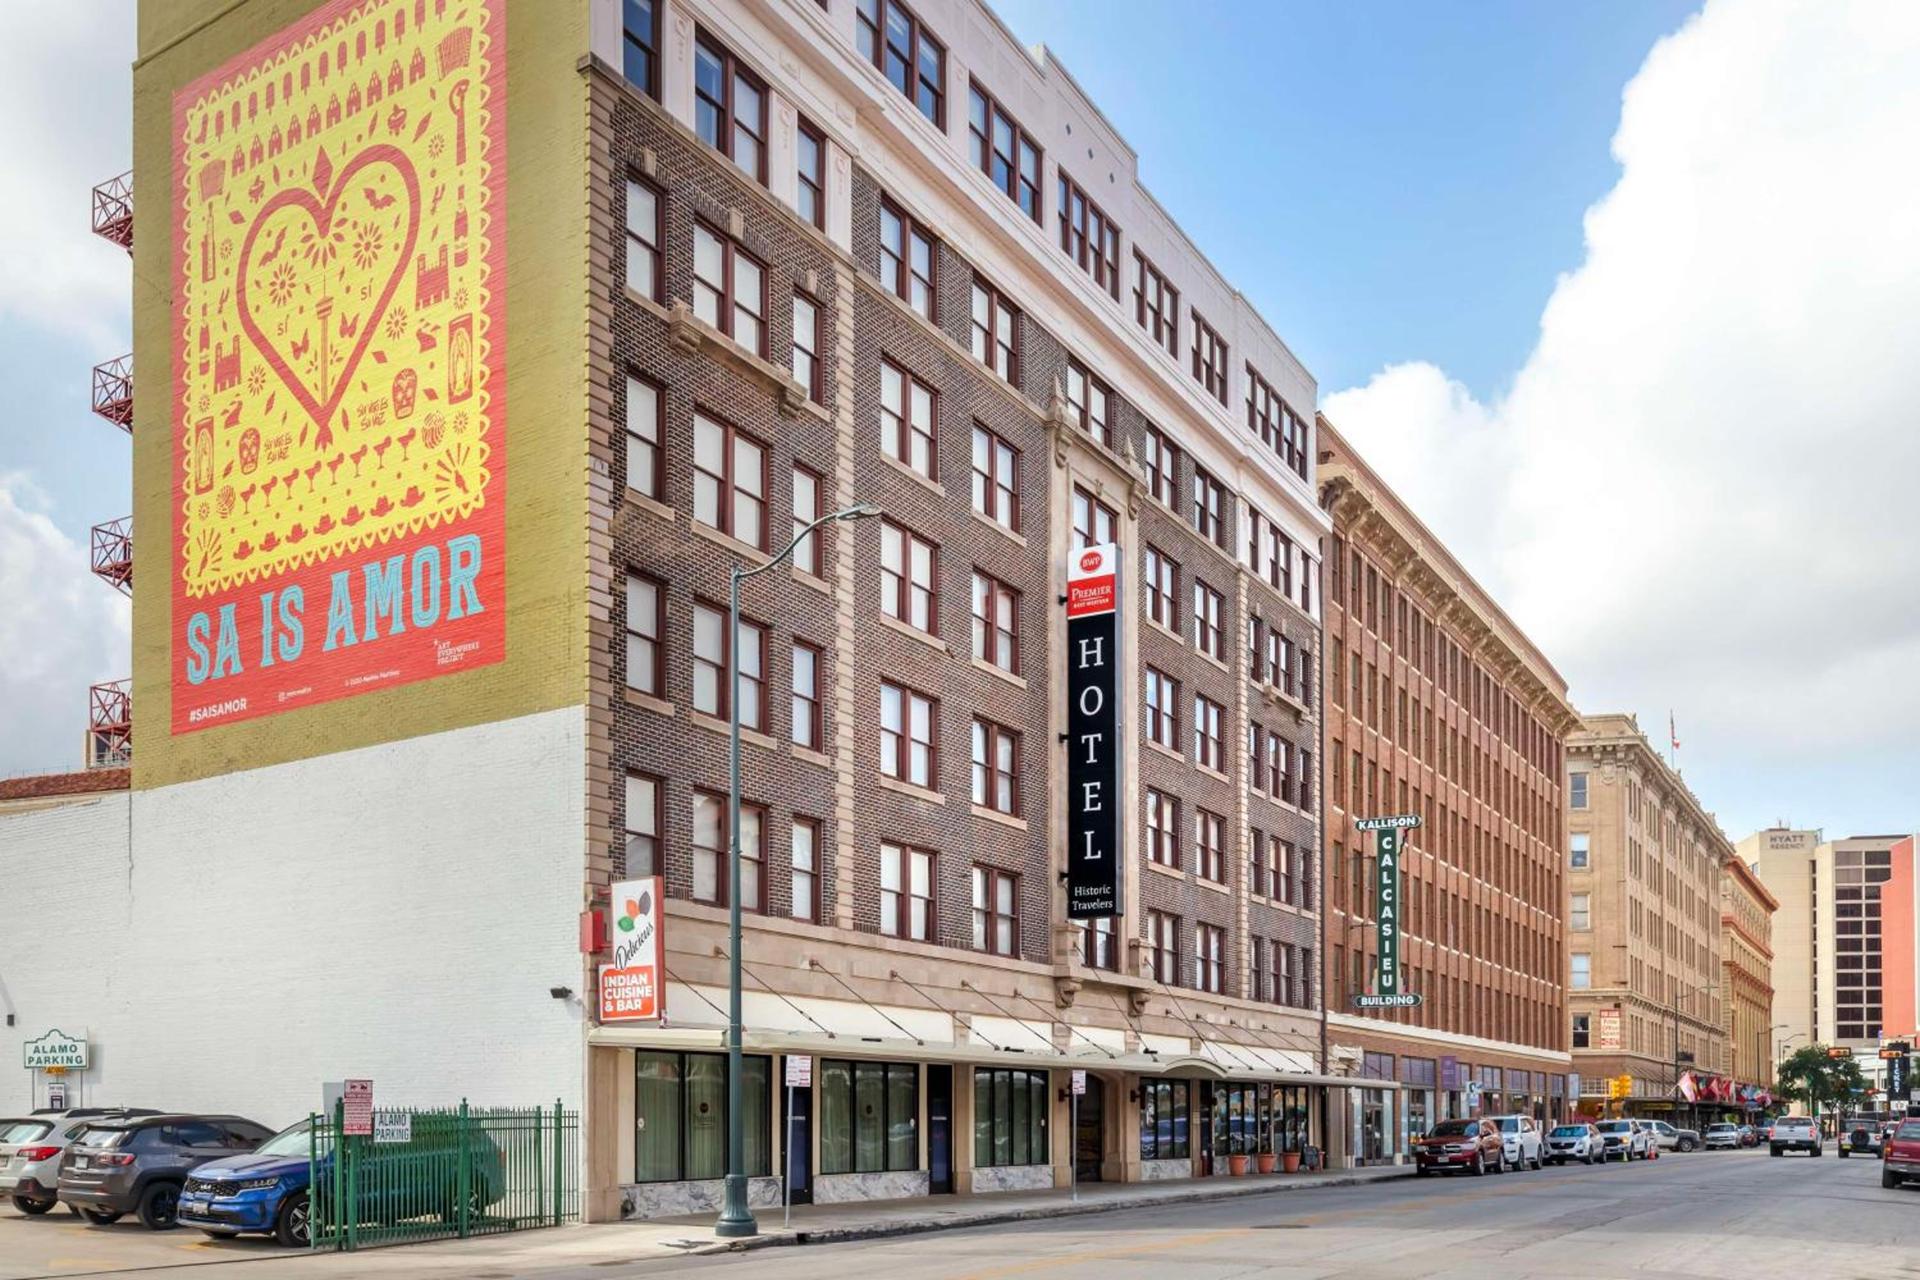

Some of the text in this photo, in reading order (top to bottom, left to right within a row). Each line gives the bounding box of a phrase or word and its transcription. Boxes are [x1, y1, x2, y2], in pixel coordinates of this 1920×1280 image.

[1071, 585, 1112, 601] PREMIER
[186, 533, 485, 685] SA IS AMOR
[190, 698, 247, 723] #SAISAMOR
[1078, 636, 1104, 860] HOTEL
[1358, 816, 1416, 830] KALLISON
[1770, 834, 1805, 843] HYATT
[1074, 884, 1112, 897] Historic
[1072, 898, 1113, 911] Travelers
[1381, 836, 1393, 987] CALCASIEU
[615, 922, 653, 970] Delicious
[604, 973, 648, 987] INDIAN
[604, 985, 653, 1000] CUISINE
[604, 1000, 642, 1012] & BAR
[1361, 995, 1414, 1006] BUILDING
[33, 1045, 78, 1054] ALAMO
[27, 1055, 83, 1065] PARKING
[378, 1114, 407, 1127] ALAMO
[375, 1128, 410, 1141] PARKING
